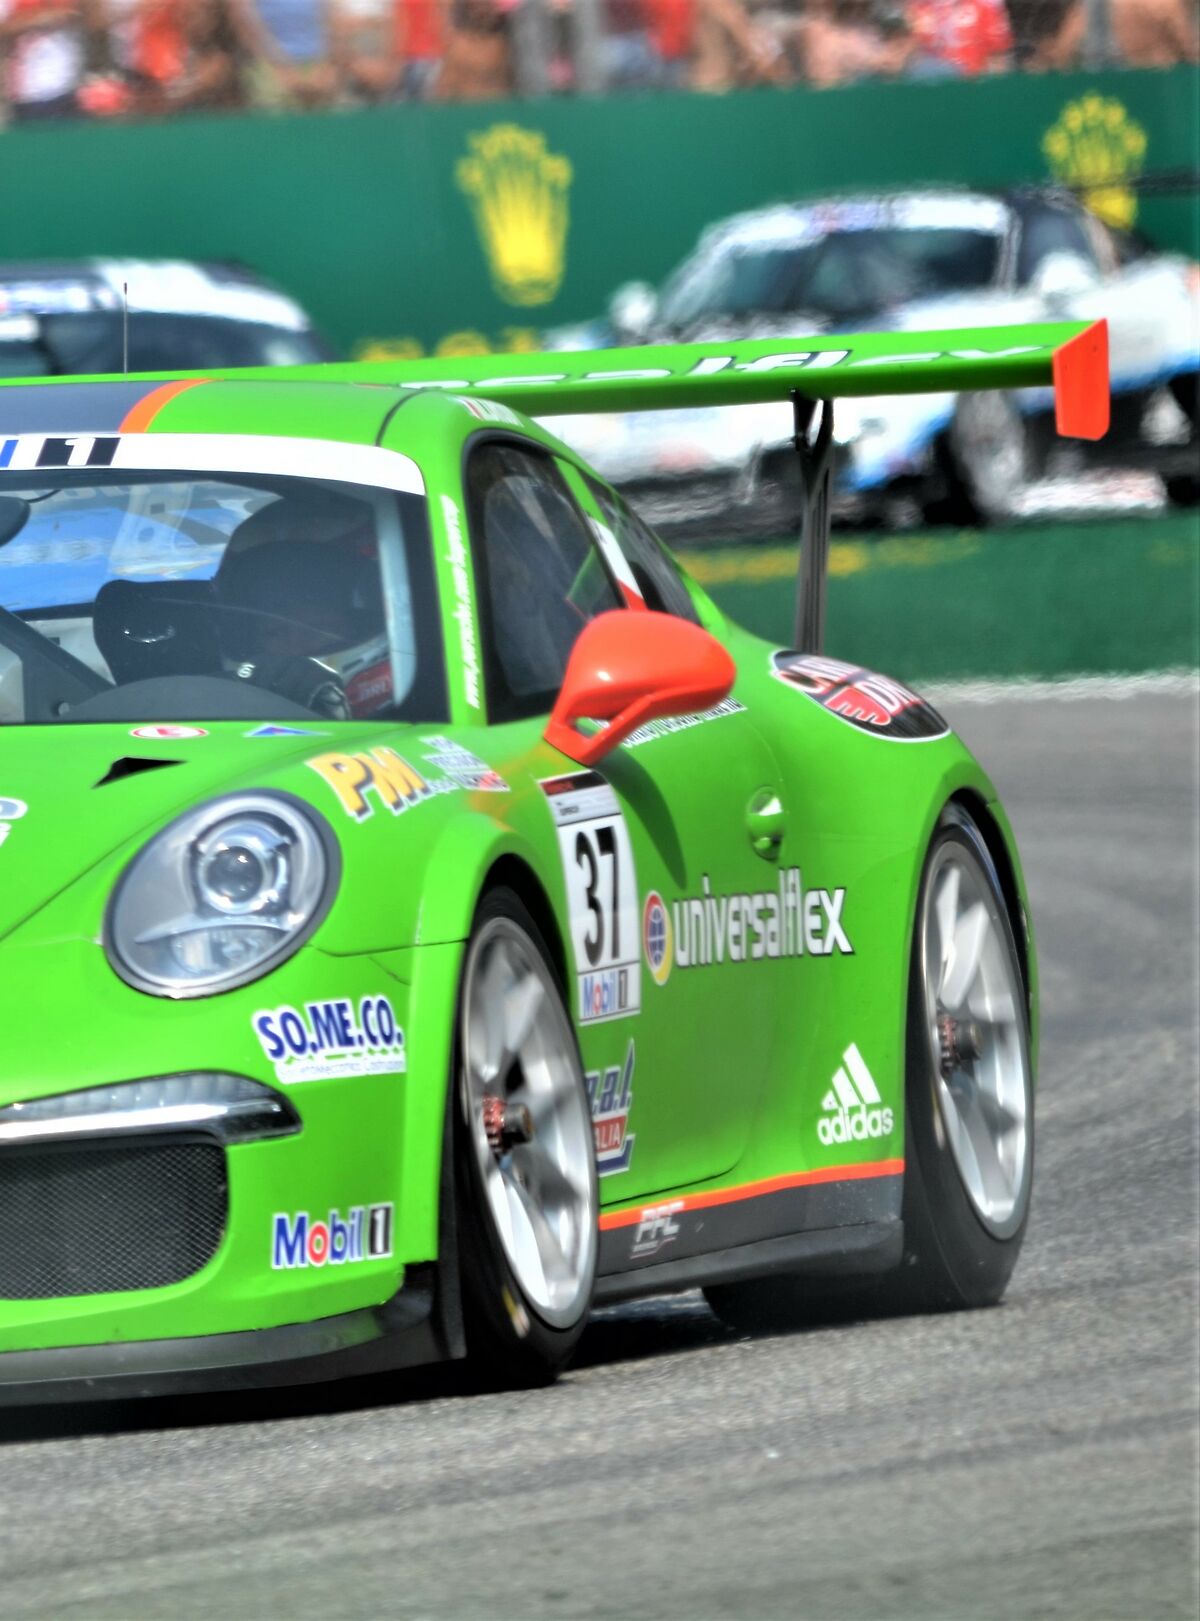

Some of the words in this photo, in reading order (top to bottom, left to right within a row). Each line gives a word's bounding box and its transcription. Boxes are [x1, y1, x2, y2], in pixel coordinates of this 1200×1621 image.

[50, 437, 110, 467] 1
[304, 747, 430, 823] PM
[575, 826, 621, 967] 37
[672, 866, 856, 969] universalflex
[583, 971, 616, 1016] Mobil
[257, 999, 404, 1059] SO.ME.CO.
[817, 1104, 894, 1146] adidas
[275, 1208, 364, 1266] Mobil
[372, 1206, 390, 1254] 1
